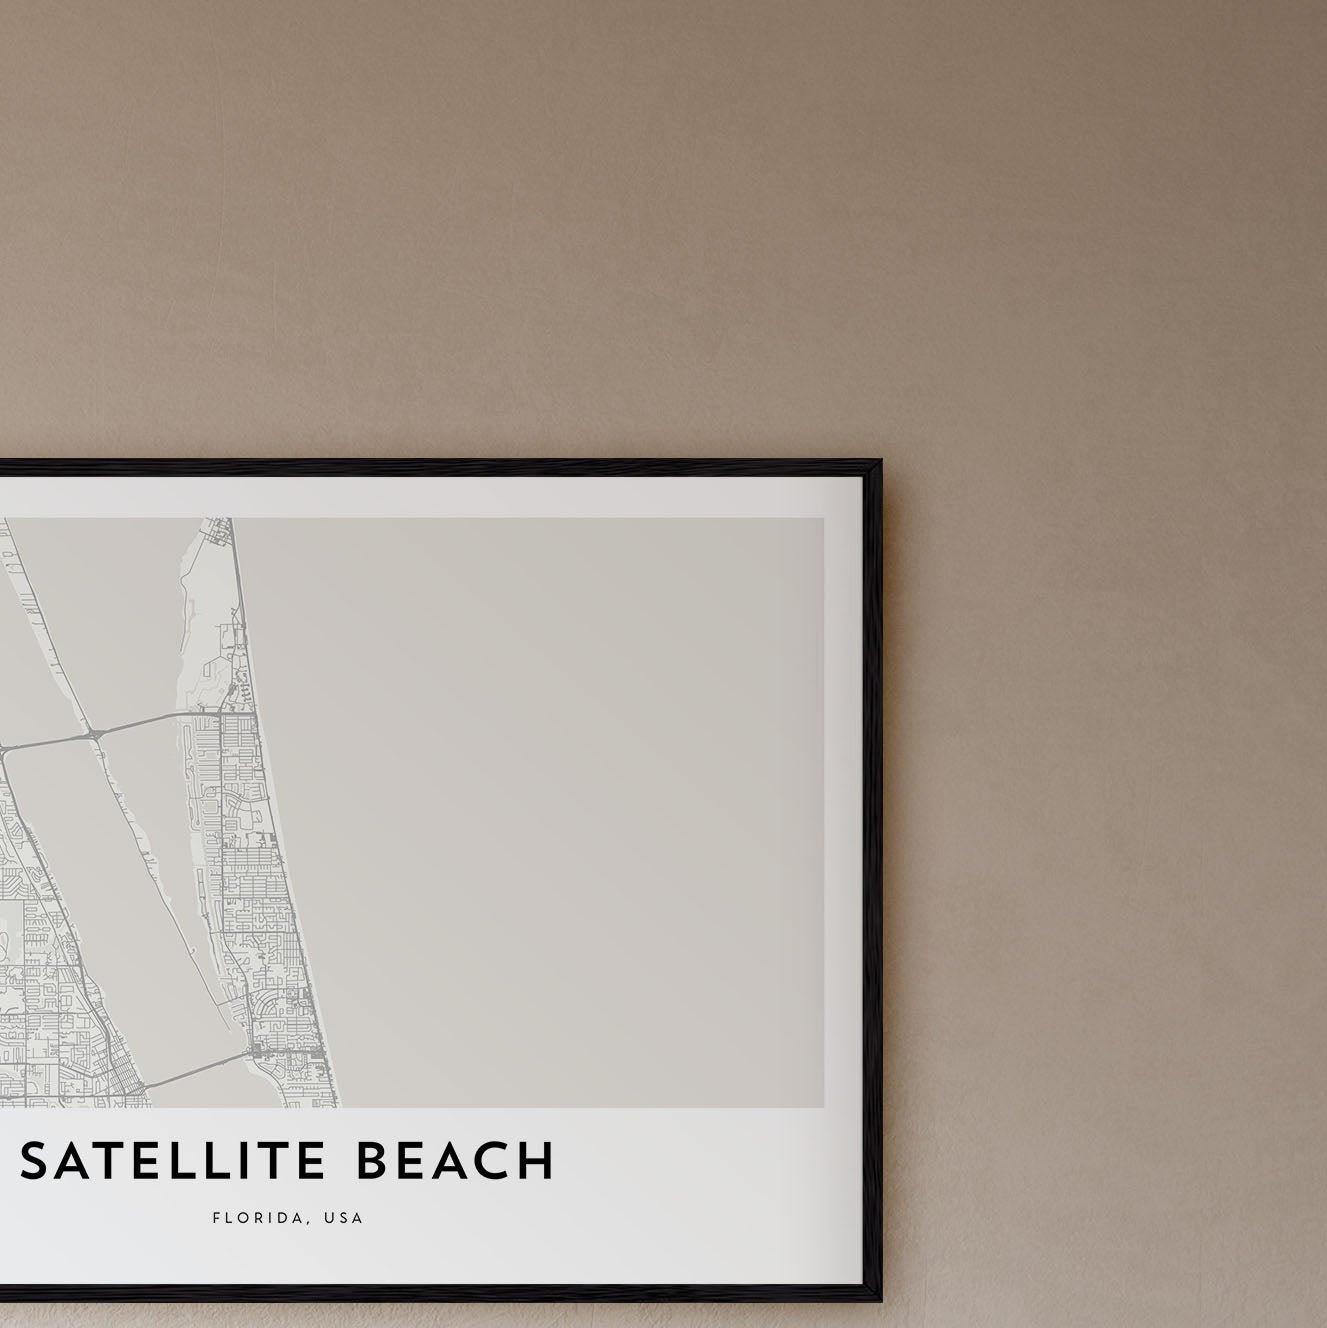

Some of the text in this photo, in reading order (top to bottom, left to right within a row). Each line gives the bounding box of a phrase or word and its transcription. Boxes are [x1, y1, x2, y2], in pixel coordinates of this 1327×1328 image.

[19, 1140, 553, 1181] SATELLITE BEACH
[212, 1211, 363, 1226] FLORIDA, USA
